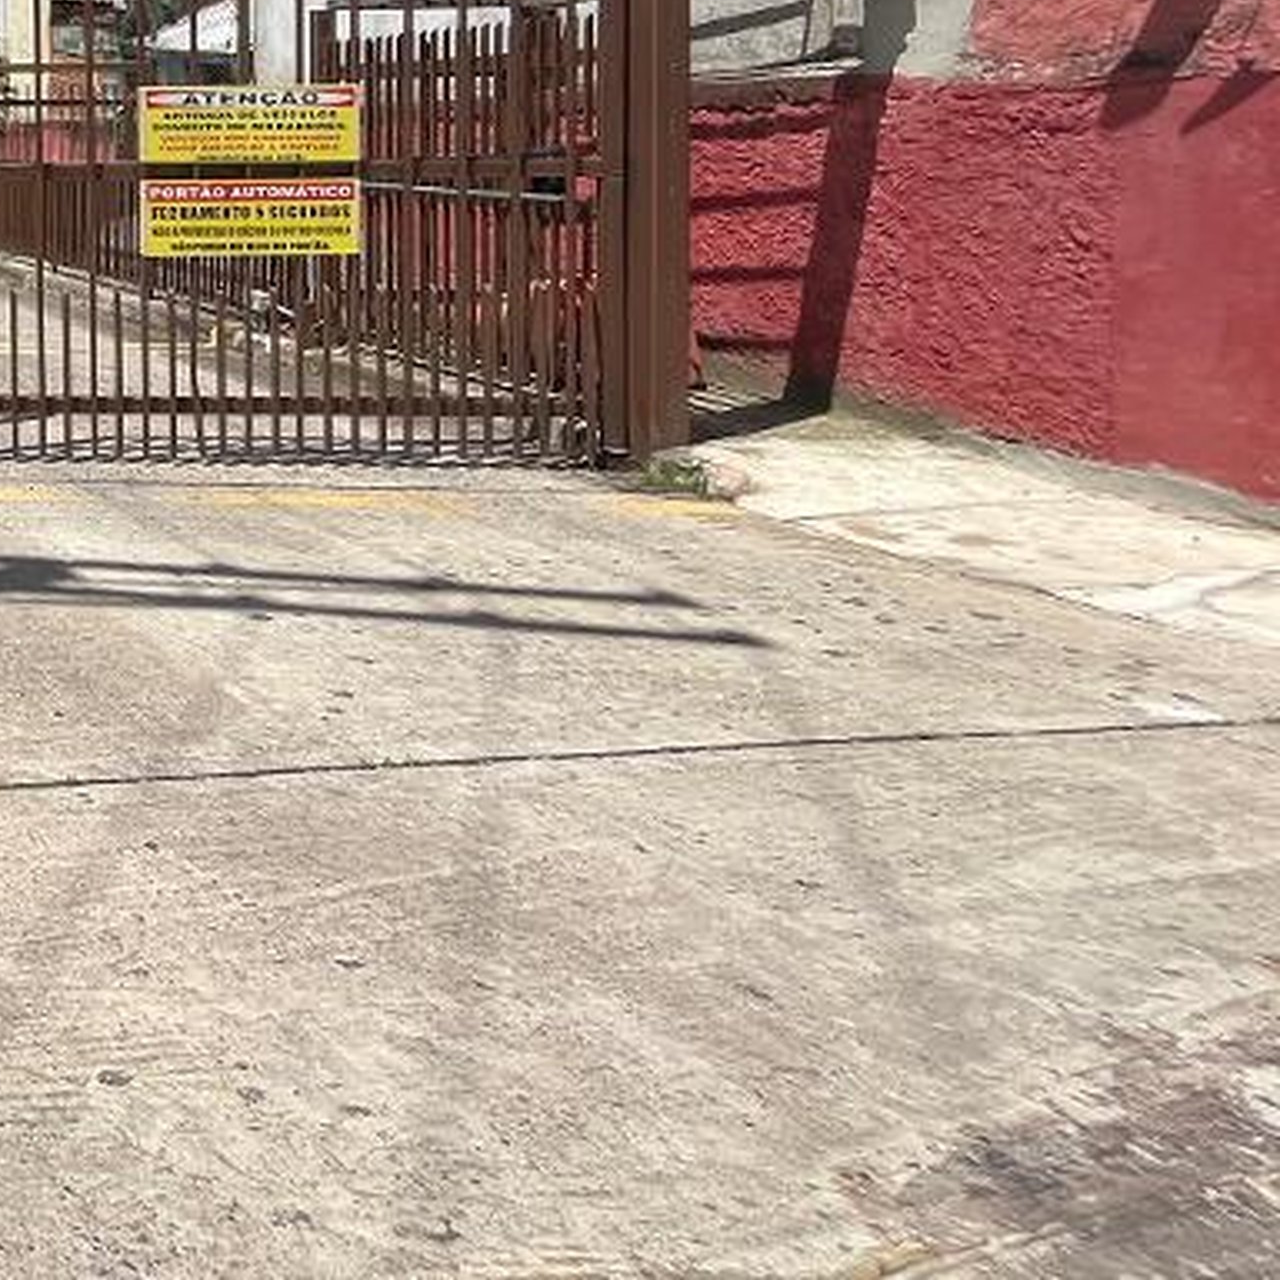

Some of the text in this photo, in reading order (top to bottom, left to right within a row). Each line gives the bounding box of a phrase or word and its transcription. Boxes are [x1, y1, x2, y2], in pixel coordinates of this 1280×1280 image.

[184, 90, 319, 108] ATENÇÃO
[149, 182, 352, 198] PORTÃO AUTOMÁTICO
